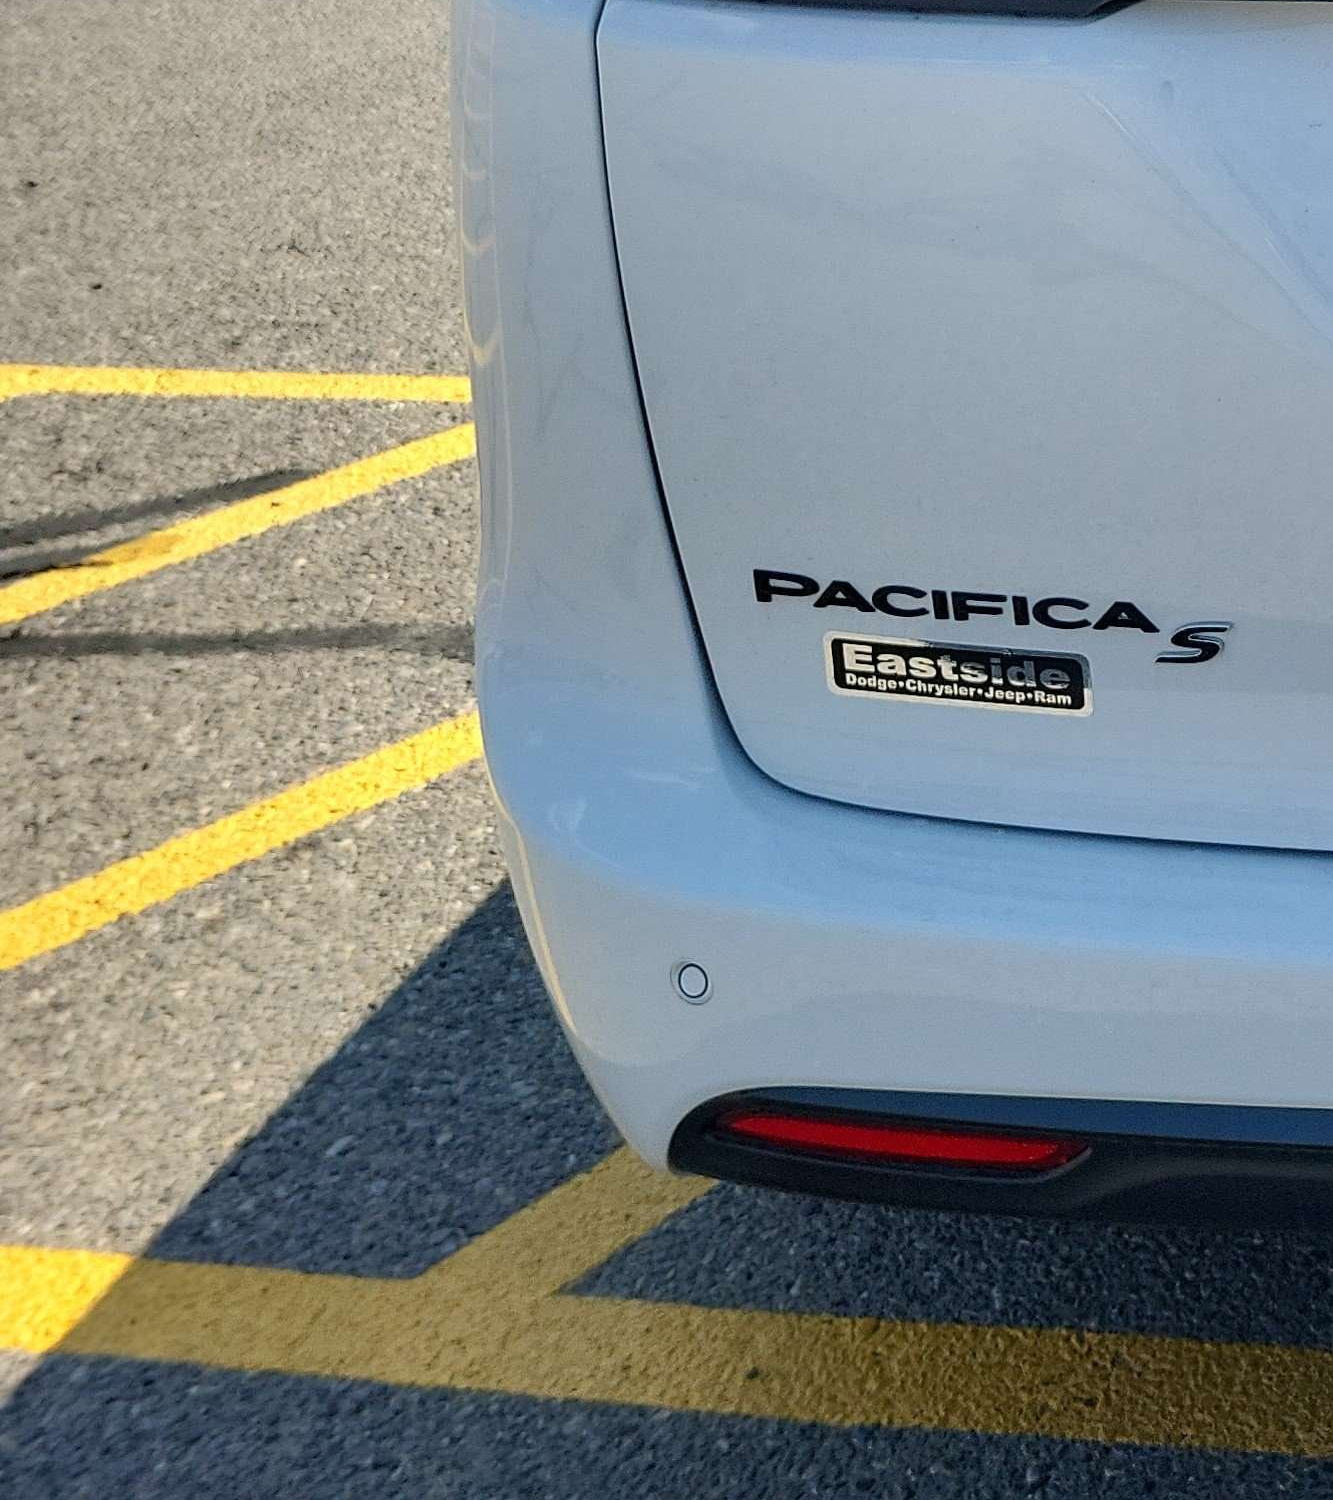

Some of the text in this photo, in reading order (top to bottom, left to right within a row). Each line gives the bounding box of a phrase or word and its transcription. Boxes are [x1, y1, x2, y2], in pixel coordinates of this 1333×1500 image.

[752, 568, 1234, 664] PACIFICA S
[841, 642, 1071, 691] Eastside
